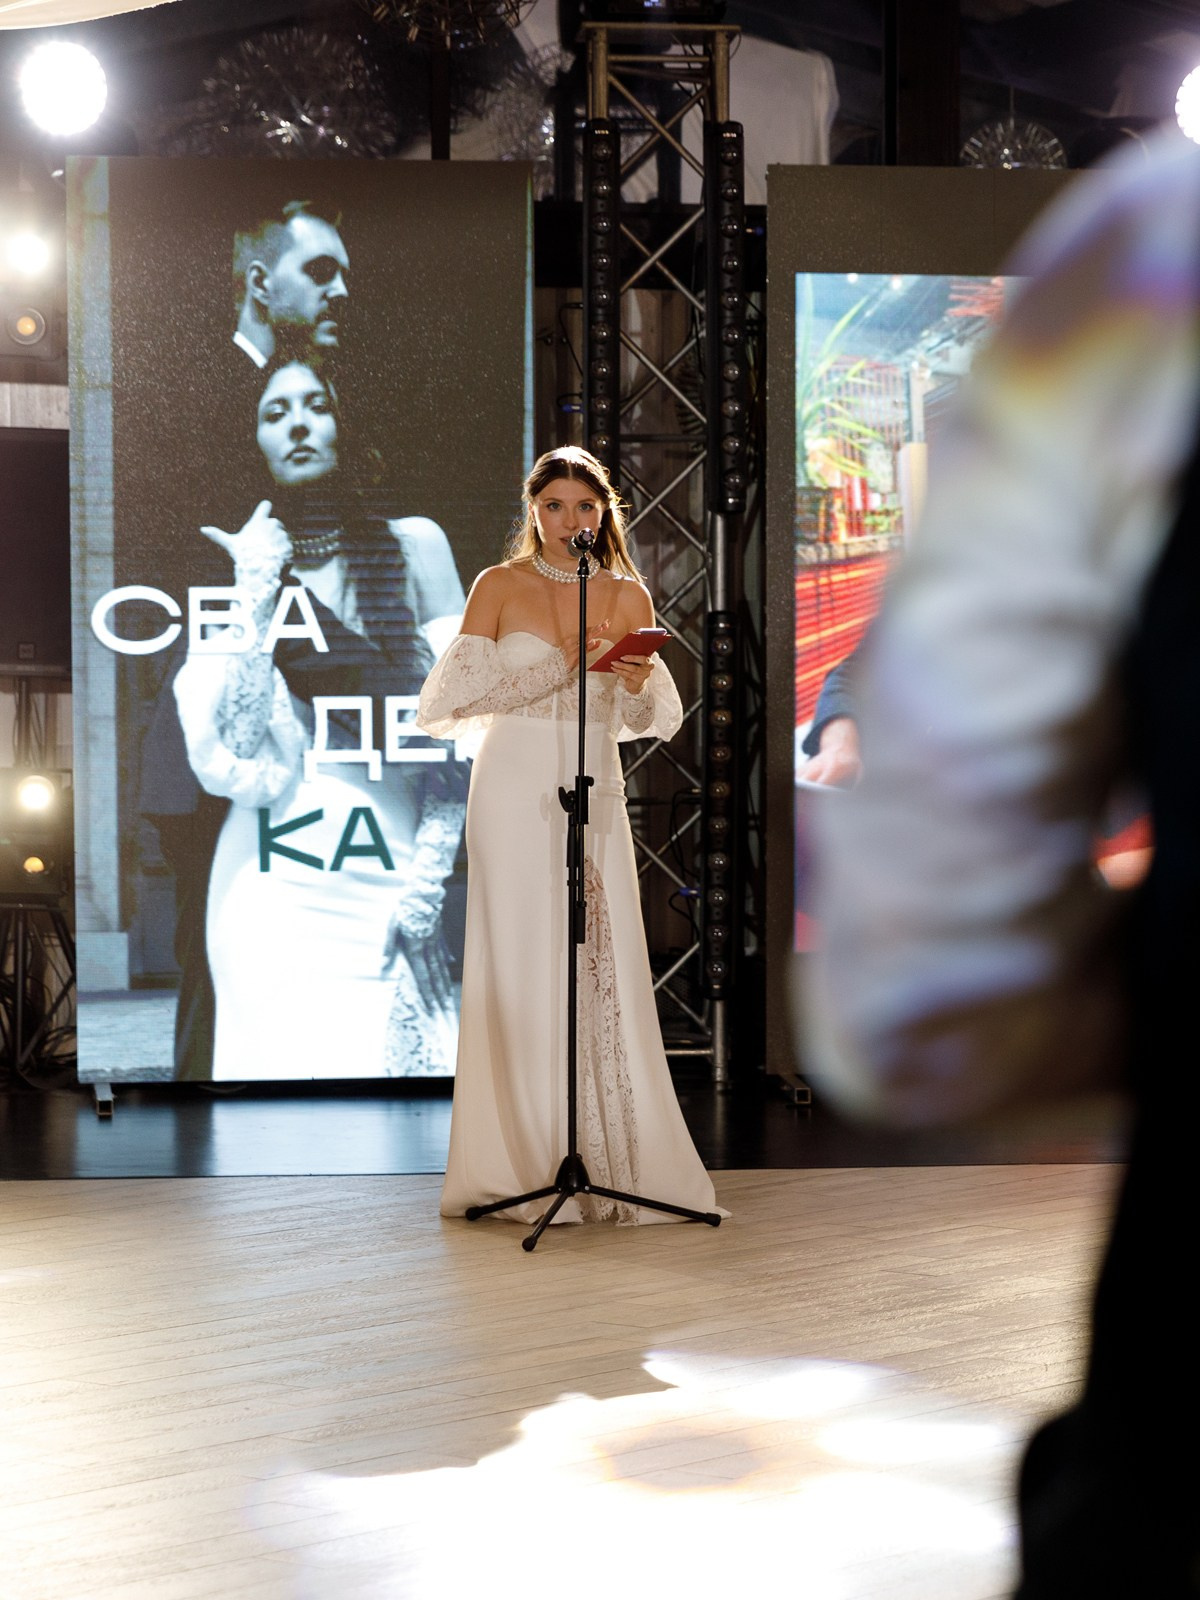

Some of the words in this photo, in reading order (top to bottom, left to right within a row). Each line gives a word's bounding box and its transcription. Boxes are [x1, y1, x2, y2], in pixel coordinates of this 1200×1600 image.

[91, 585, 329, 655] СВА
[304, 695, 478, 781] ДЕ
[258, 806, 396, 872] КА
